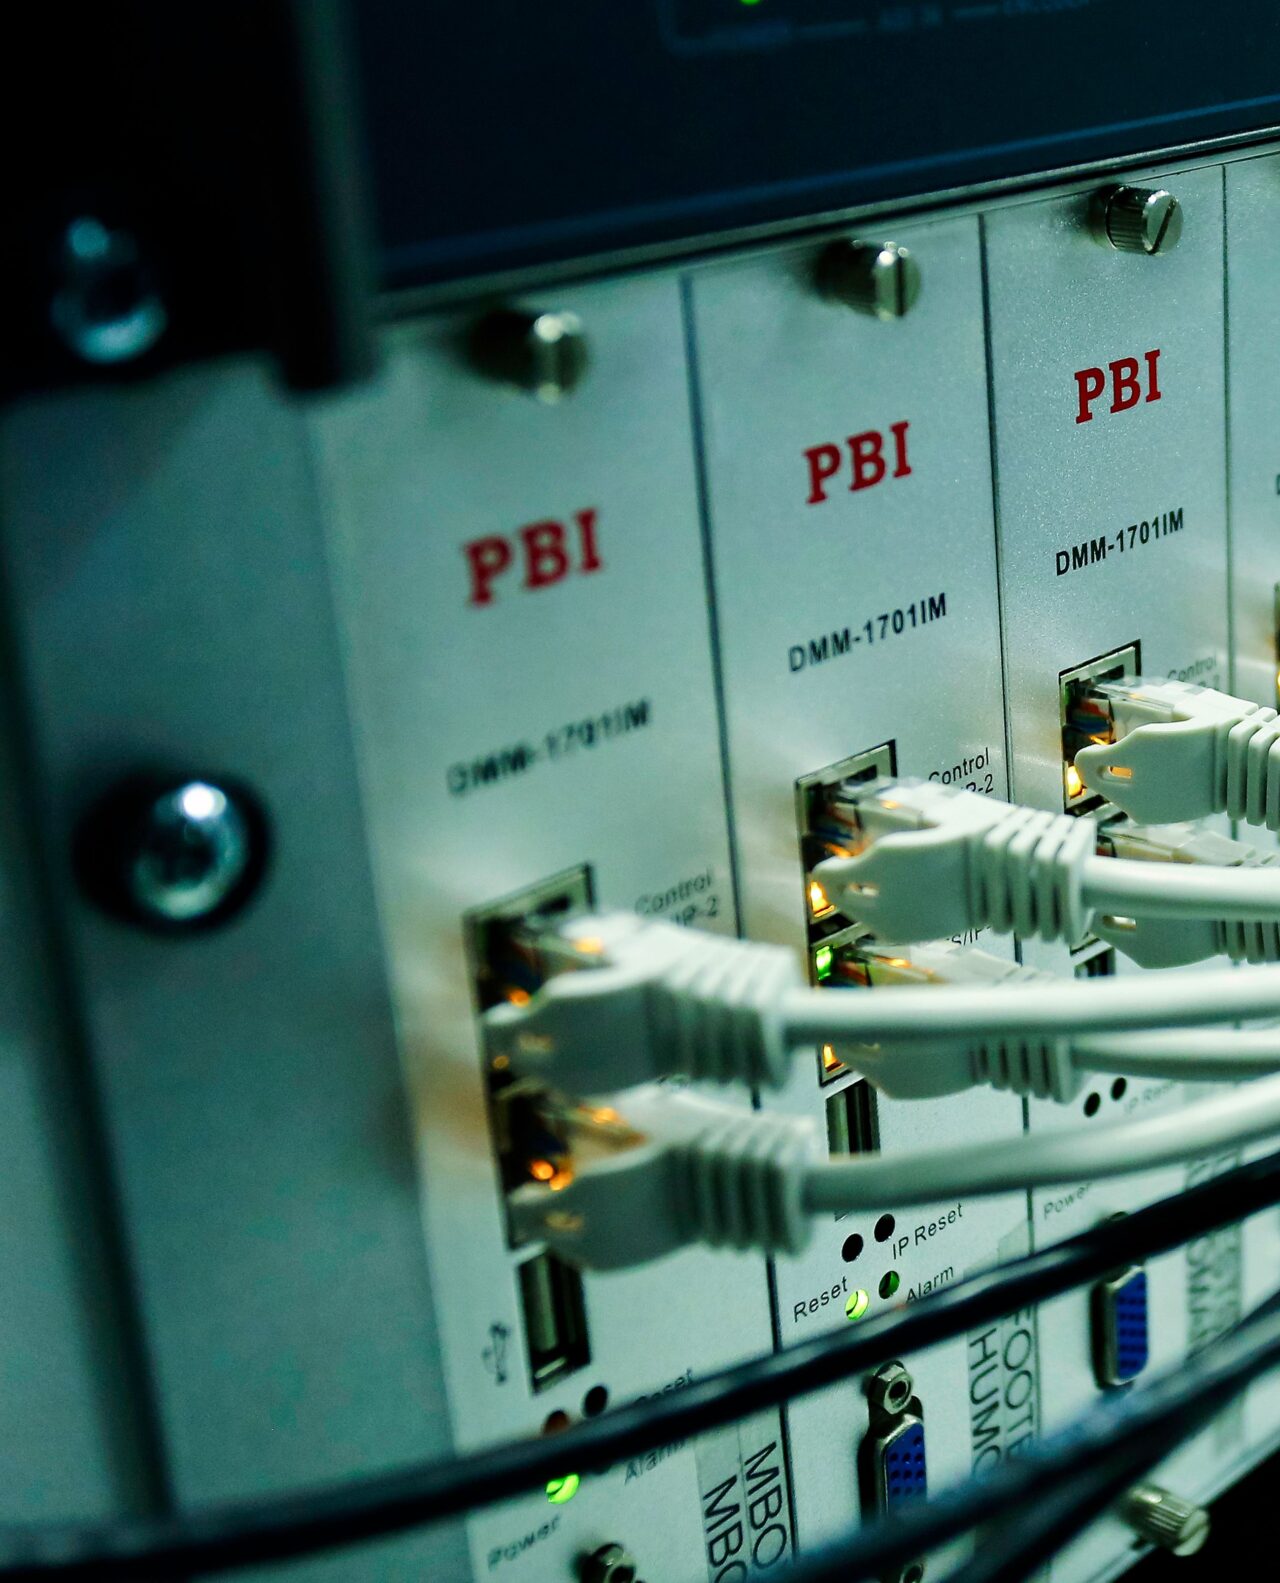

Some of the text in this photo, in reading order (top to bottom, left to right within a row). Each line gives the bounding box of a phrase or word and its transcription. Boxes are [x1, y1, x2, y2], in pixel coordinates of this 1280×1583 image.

[1074, 349, 1162, 424] PBI
[803, 421, 912, 504] PBI
[464, 509, 603, 605] PBI
[1055, 507, 1186, 577] DMM-1701IM
[788, 592, 949, 674] DMM-1701IM
[634, 865, 712, 919] Control
[892, 1202, 963, 1260] IP Reset
[793, 1276, 849, 1323] Reset
[905, 1265, 954, 1303] Alarm
